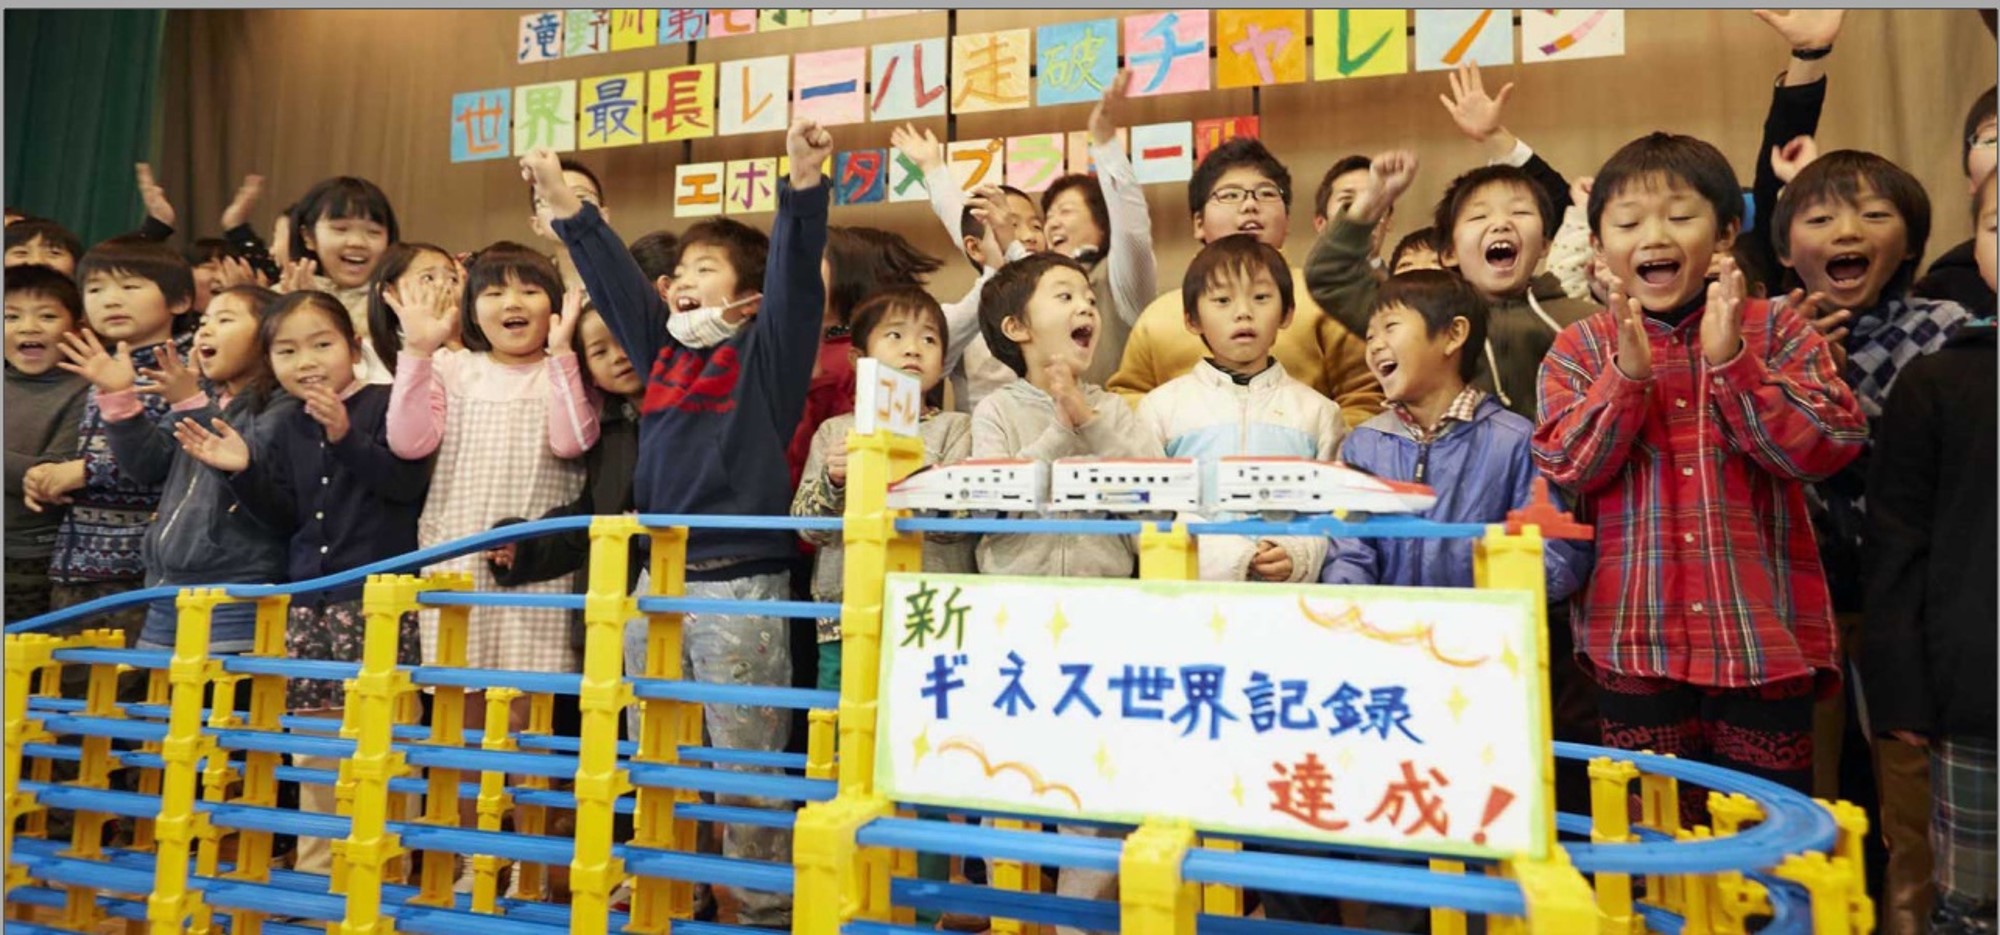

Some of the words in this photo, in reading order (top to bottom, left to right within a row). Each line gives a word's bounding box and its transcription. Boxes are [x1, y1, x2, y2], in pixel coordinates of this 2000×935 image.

[901, 581, 972, 651] 新
[920, 649, 1424, 744] ギネス世界記録
